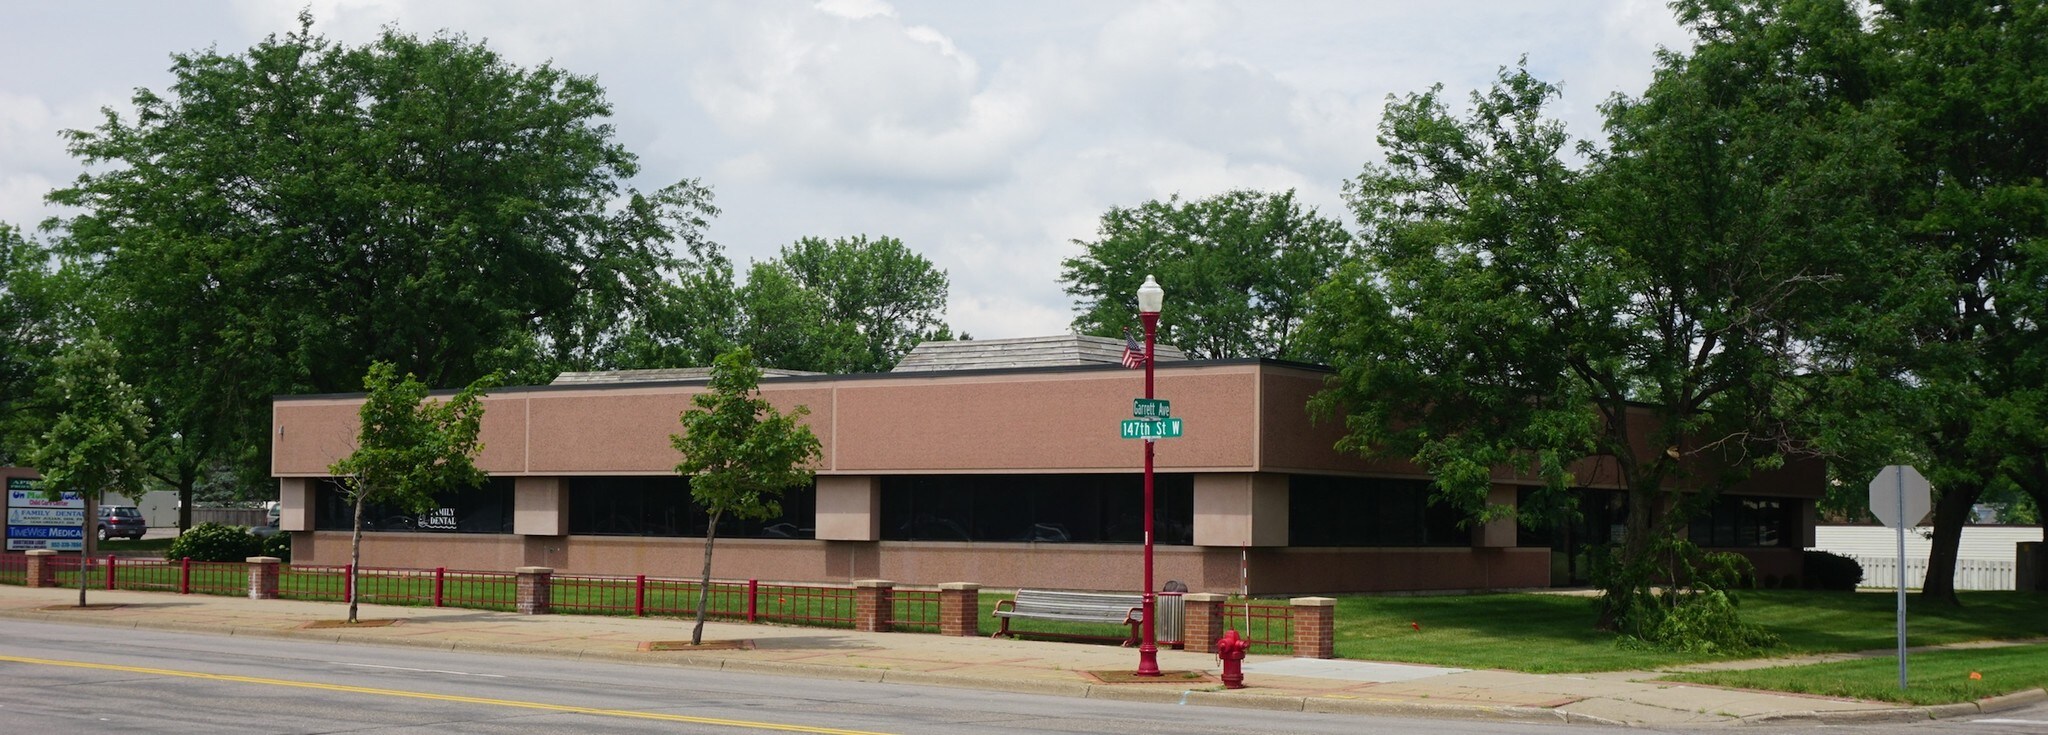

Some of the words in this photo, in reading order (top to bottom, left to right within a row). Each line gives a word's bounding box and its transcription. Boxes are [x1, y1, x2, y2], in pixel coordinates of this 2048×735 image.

[1134, 400, 1155, 415] Garrett
[1158, 402, 1170, 416] Ave
[1123, 422, 1150, 436] 147th
[1156, 421, 1166, 435] St
[1172, 420, 1180, 435] W
[430, 507, 456, 516] MILY
[430, 516, 457, 525] DENTAL
